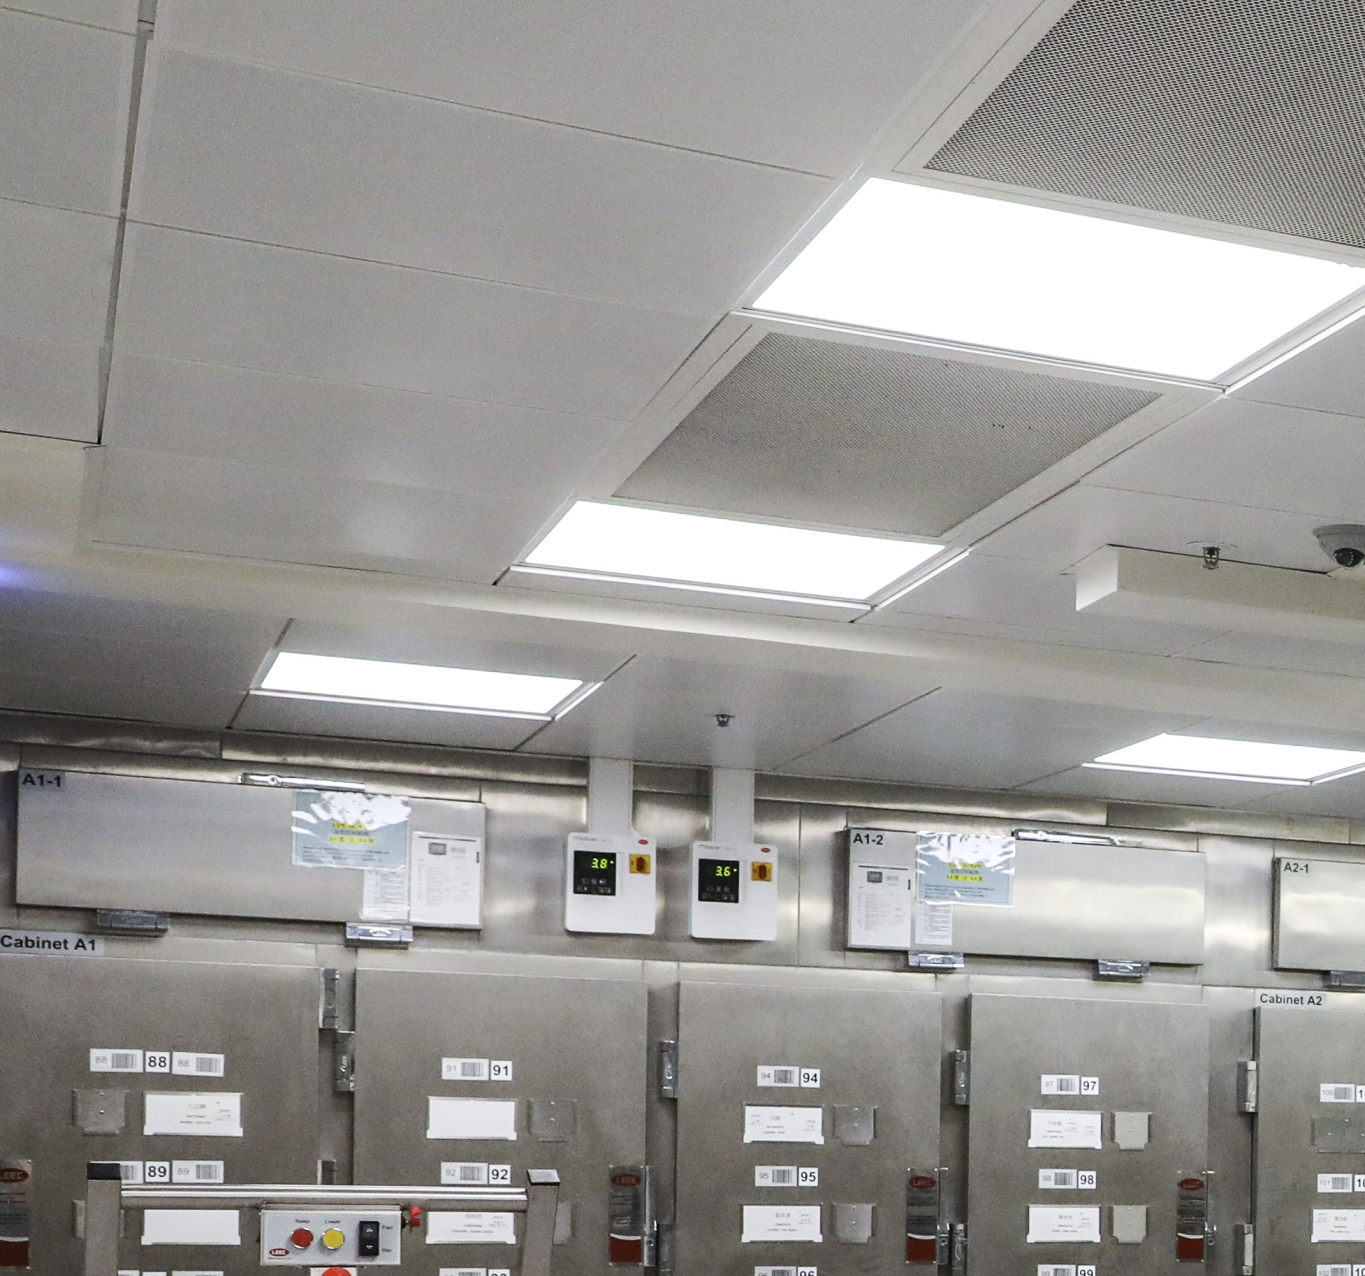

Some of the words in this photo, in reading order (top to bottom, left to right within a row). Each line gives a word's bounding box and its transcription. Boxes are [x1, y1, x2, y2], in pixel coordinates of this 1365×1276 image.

[22, 773, 62, 788] A1-1
[853, 832, 884, 846] A1-2
[1283, 862, 1310, 874] A2-1
[0, 934, 69, 951] Cabinet
[74, 938, 97, 951] A1
[1259, 993, 1304, 1006] Cabinet
[1306, 995, 1323, 1006] A2
[147, 1055, 167, 1068] 88
[492, 1064, 509, 1076] 91
[802, 1072, 818, 1084] 94
[1082, 1080, 1097, 1091] 97
[147, 1165, 167, 1178] 89
[491, 1168, 508, 1181] 92
[800, 1171, 817, 1183] 95
[1080, 1174, 1094, 1185] 98
